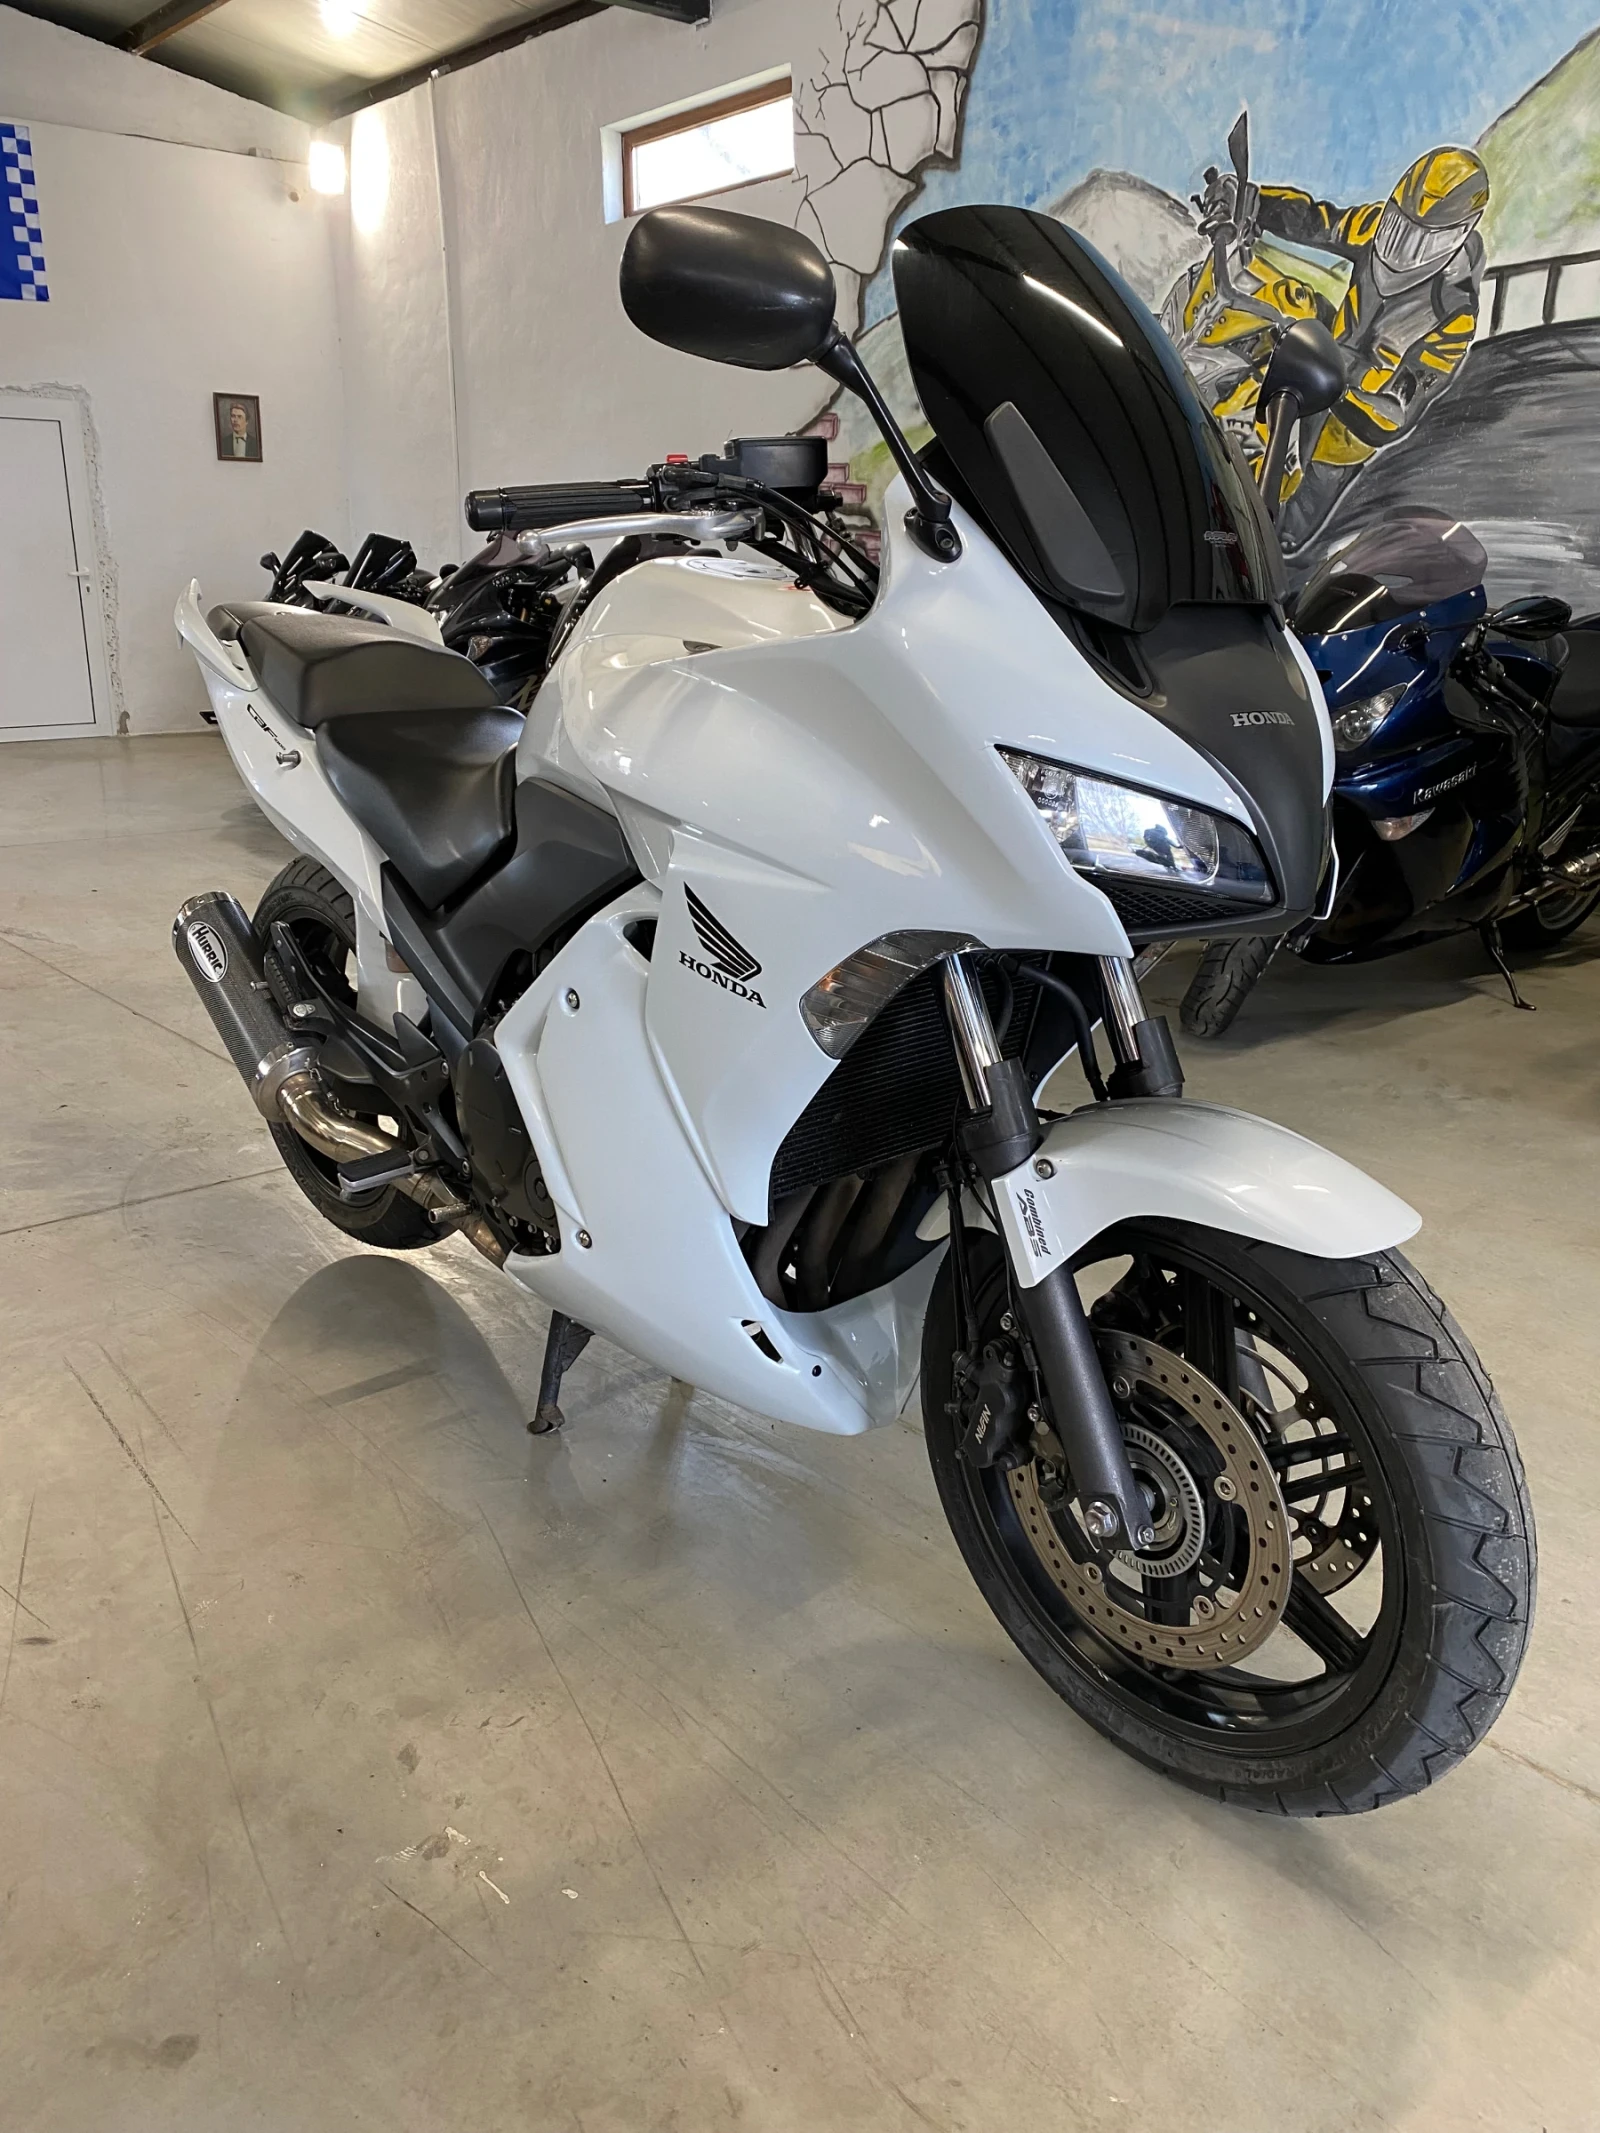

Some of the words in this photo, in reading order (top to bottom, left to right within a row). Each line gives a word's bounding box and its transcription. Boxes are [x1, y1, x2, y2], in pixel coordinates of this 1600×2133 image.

[246, 703, 278, 738] CBF
[1229, 711, 1296, 727] HONDA
[1413, 761, 1478, 805] Kawasaki
[679, 950, 767, 1009] HONDA
[1016, 1191, 1042, 1258] ABS
[1023, 1188, 1052, 1256] Combined
